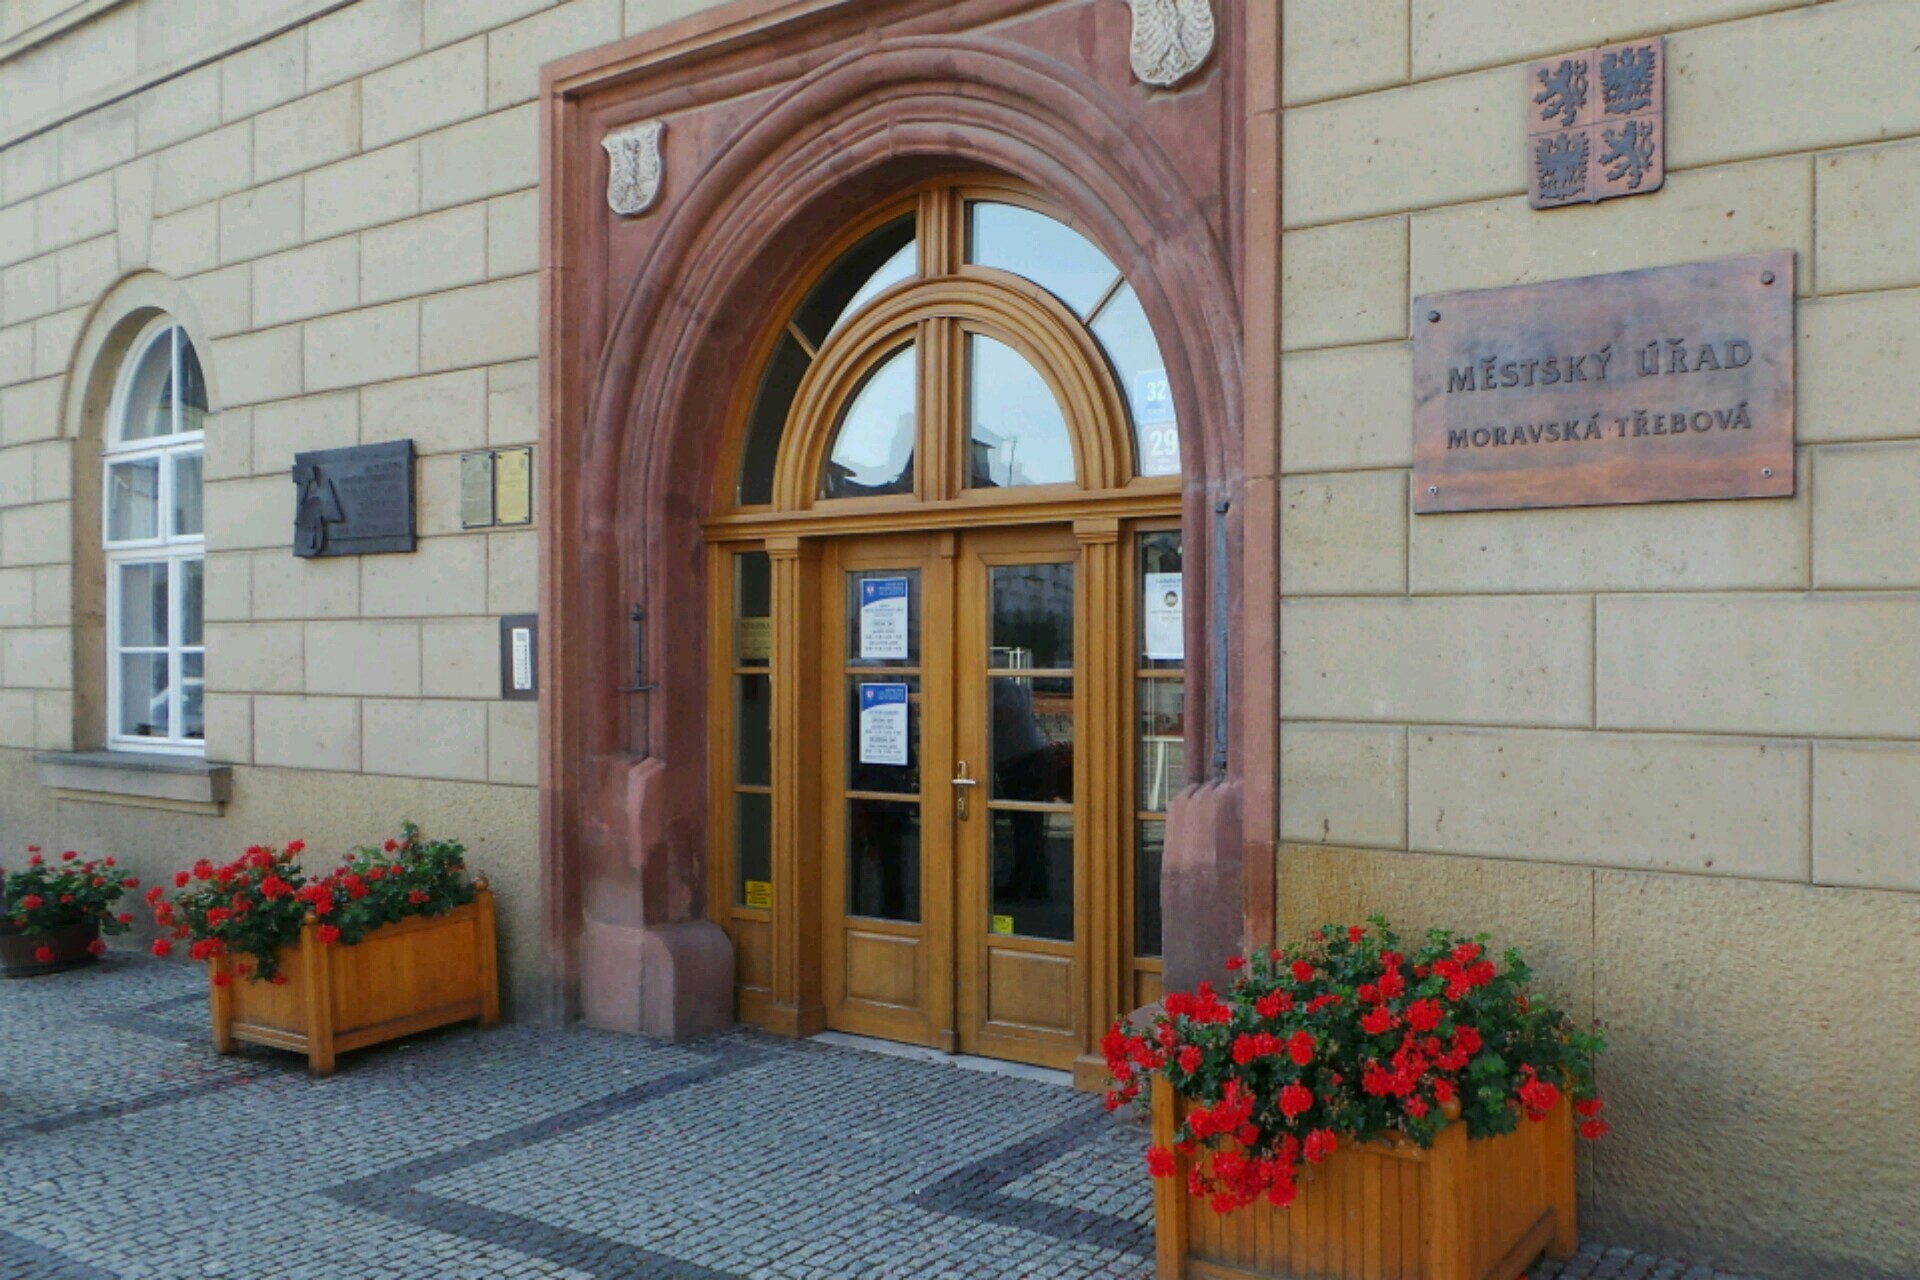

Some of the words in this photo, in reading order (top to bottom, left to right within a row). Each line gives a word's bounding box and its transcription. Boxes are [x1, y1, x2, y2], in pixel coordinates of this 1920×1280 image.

[1446, 344, 1612, 393] MĚSTSKÝ
[1636, 338, 1752, 377] ÚŘAD
[1146, 380, 1168, 402] 32
[1150, 428, 1178, 457] 29
[1446, 412, 1602, 449] MORAVSKÁ
[1614, 401, 1752, 438] TŘEBOVÁ
